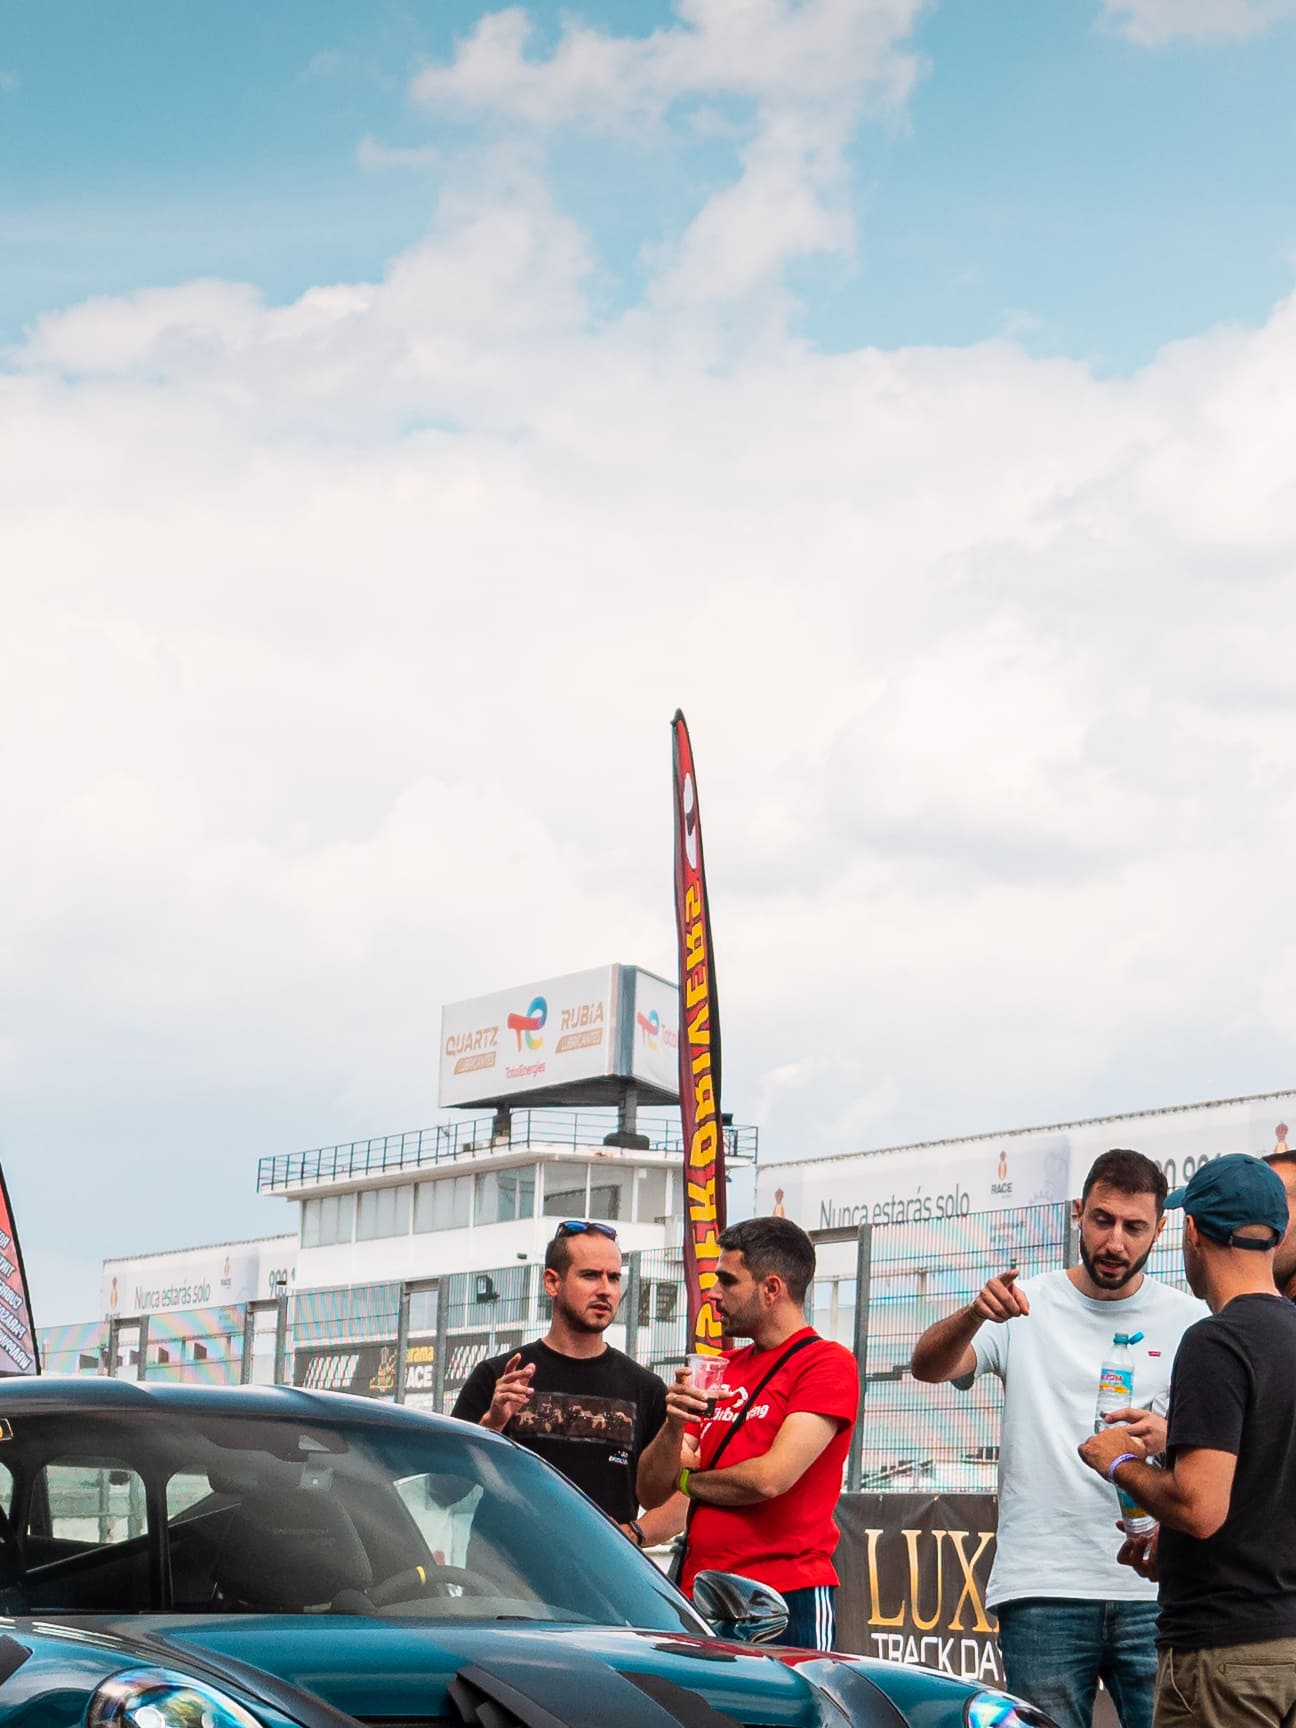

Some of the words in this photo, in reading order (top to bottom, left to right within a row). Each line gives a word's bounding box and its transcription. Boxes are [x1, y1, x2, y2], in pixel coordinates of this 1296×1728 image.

[446, 1026, 499, 1057] QUARTZ
[991, 1182, 1013, 1195] RACE
[821, 1200, 867, 1228] Nunca
[872, 1186, 932, 1225] estarás
[936, 1184, 970, 1218] solo
[135, 1284, 161, 1310] Nunca
[162, 1280, 192, 1306] estarás
[193, 1278, 211, 1304] solo
[405, 1365, 432, 1388] ACE
[865, 1529, 1000, 1632] LUX
[870, 1633, 954, 1675] TRACK
[961, 1639, 1006, 1683] DA
